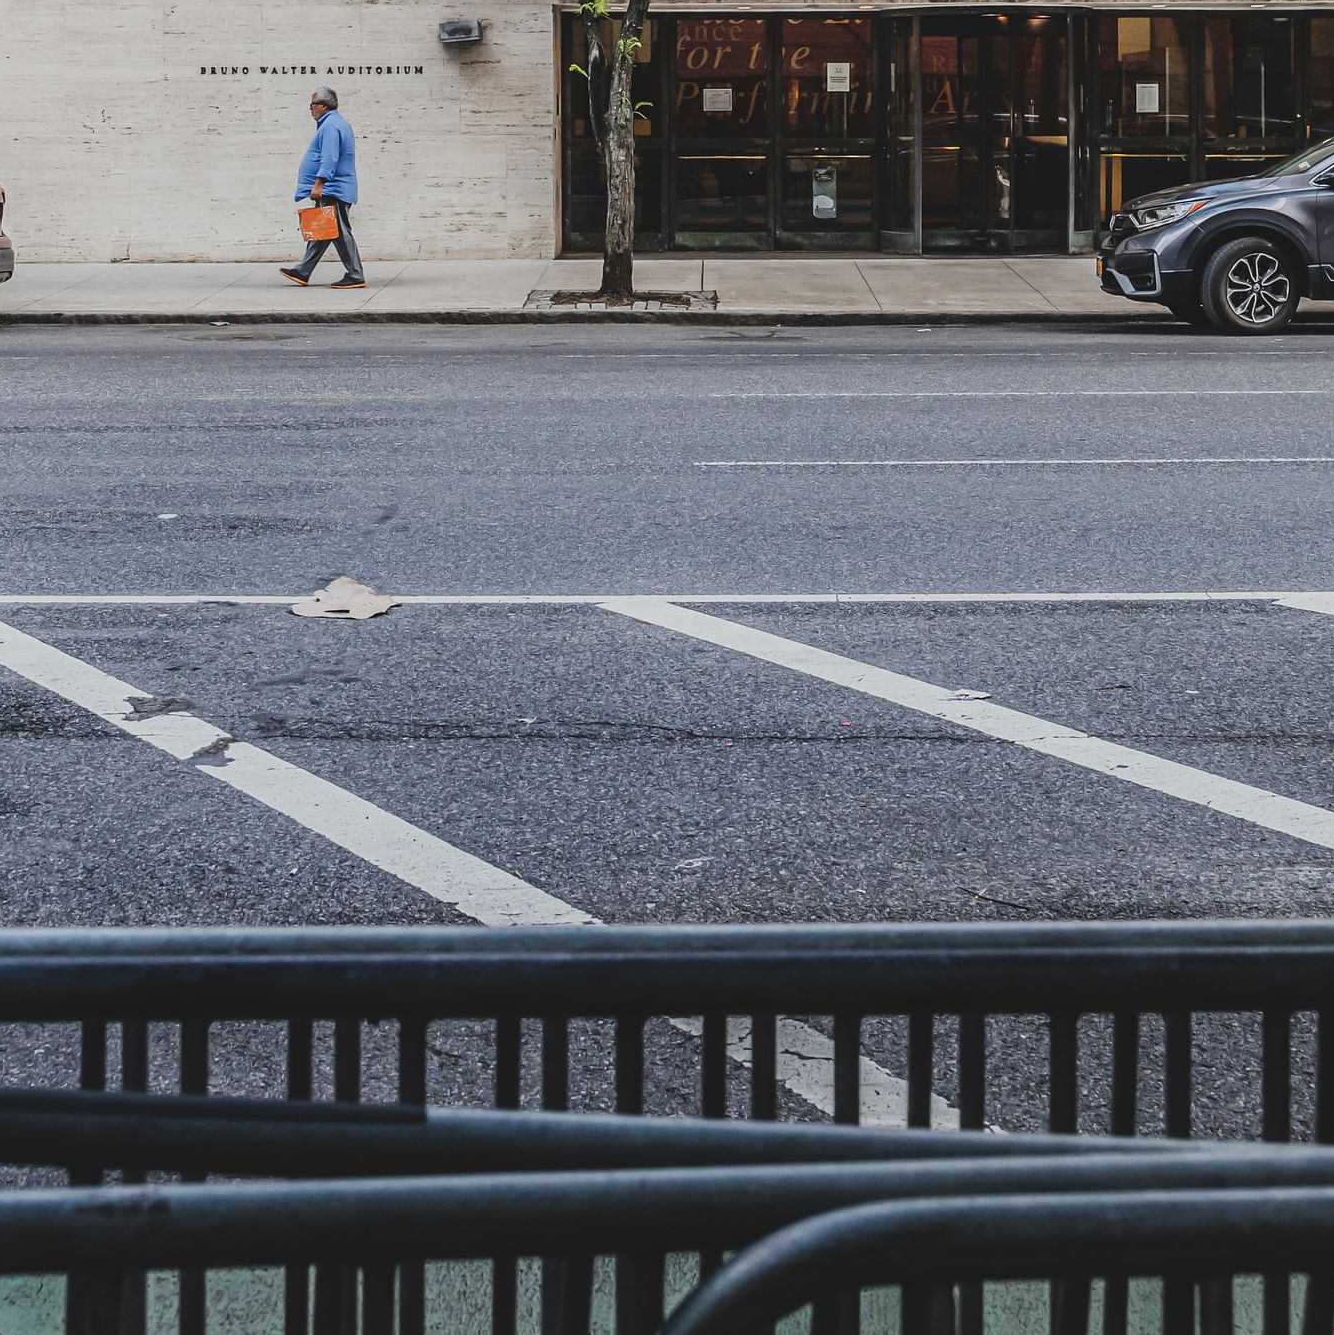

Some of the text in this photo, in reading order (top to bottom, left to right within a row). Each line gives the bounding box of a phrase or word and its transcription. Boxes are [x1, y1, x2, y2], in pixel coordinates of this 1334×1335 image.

[199, 65, 425, 76] BRUNO WALTER AUDITORIUM
